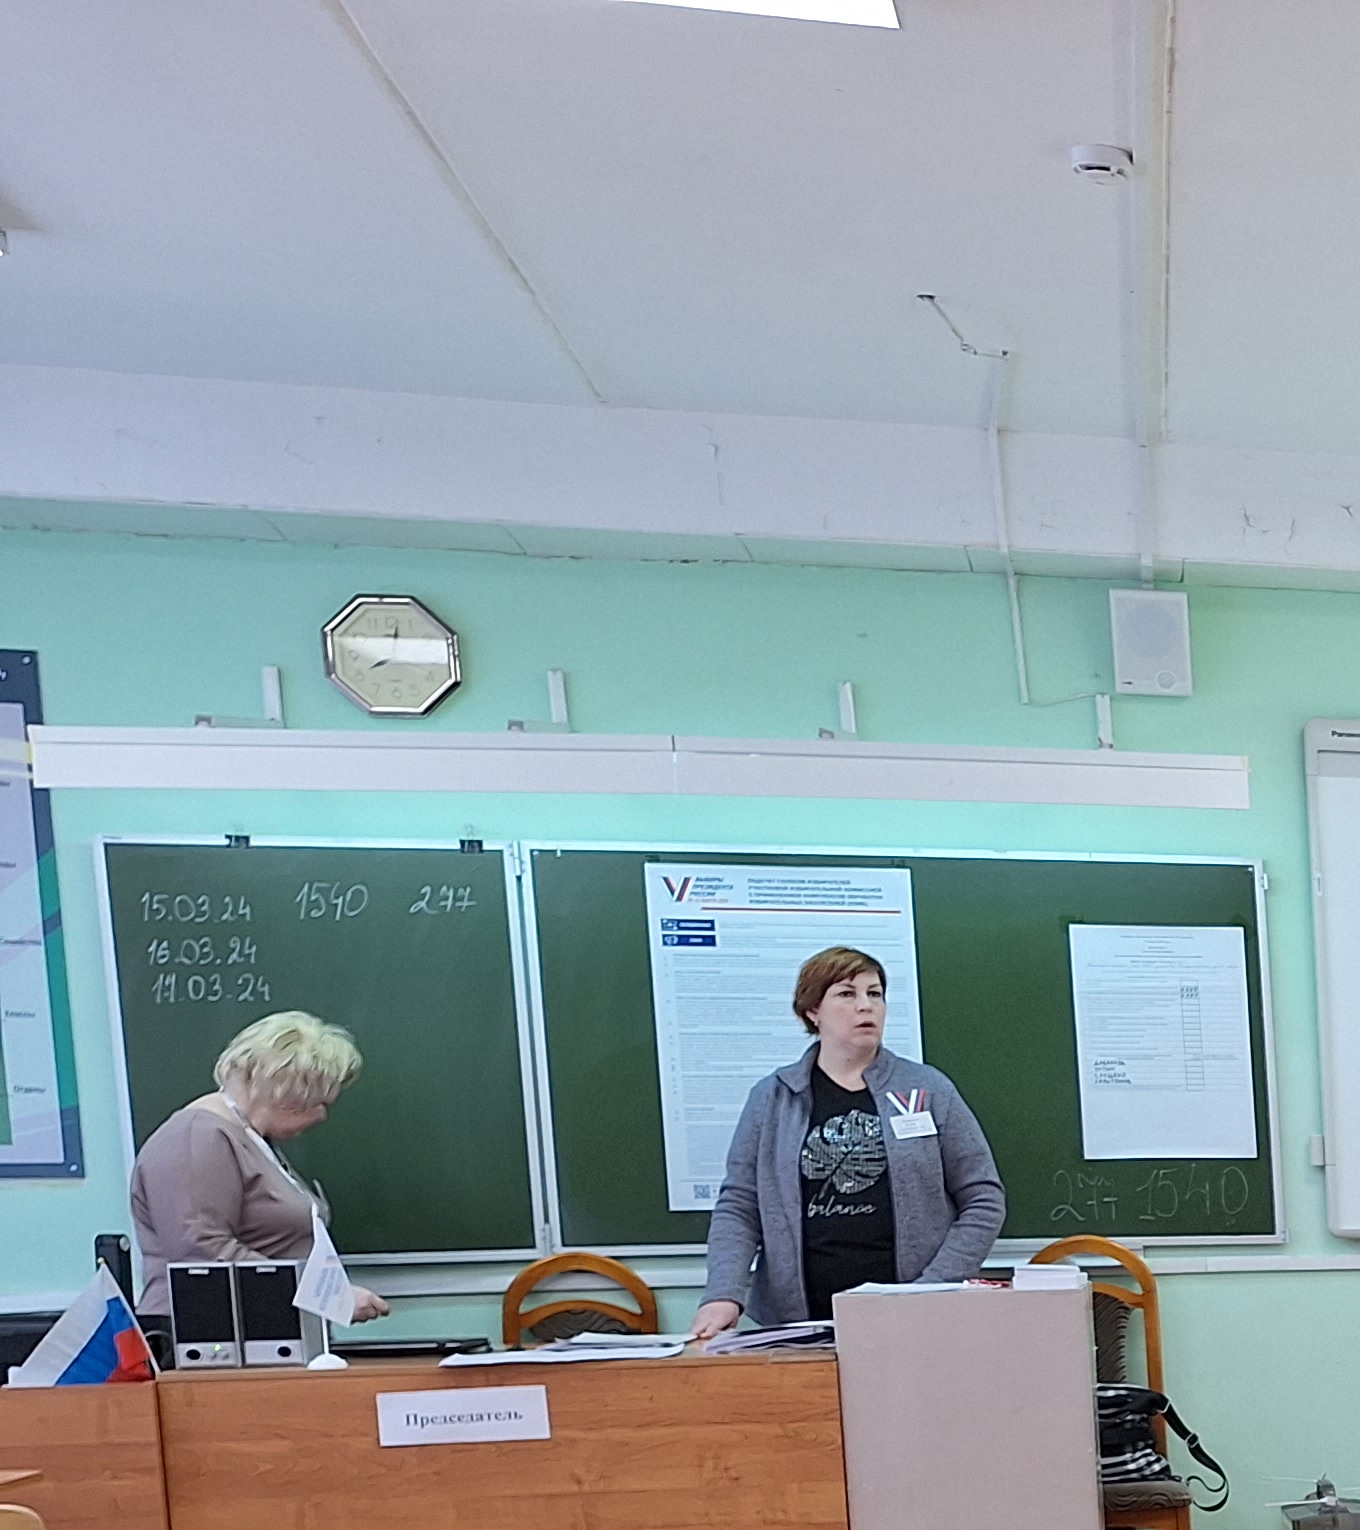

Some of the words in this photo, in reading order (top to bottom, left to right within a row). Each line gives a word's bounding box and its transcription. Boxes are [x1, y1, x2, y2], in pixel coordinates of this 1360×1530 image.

[139, 889, 252, 923] 15.03.24
[293, 880, 370, 922] 1540
[405, 1409, 524, 1430] Председатель
